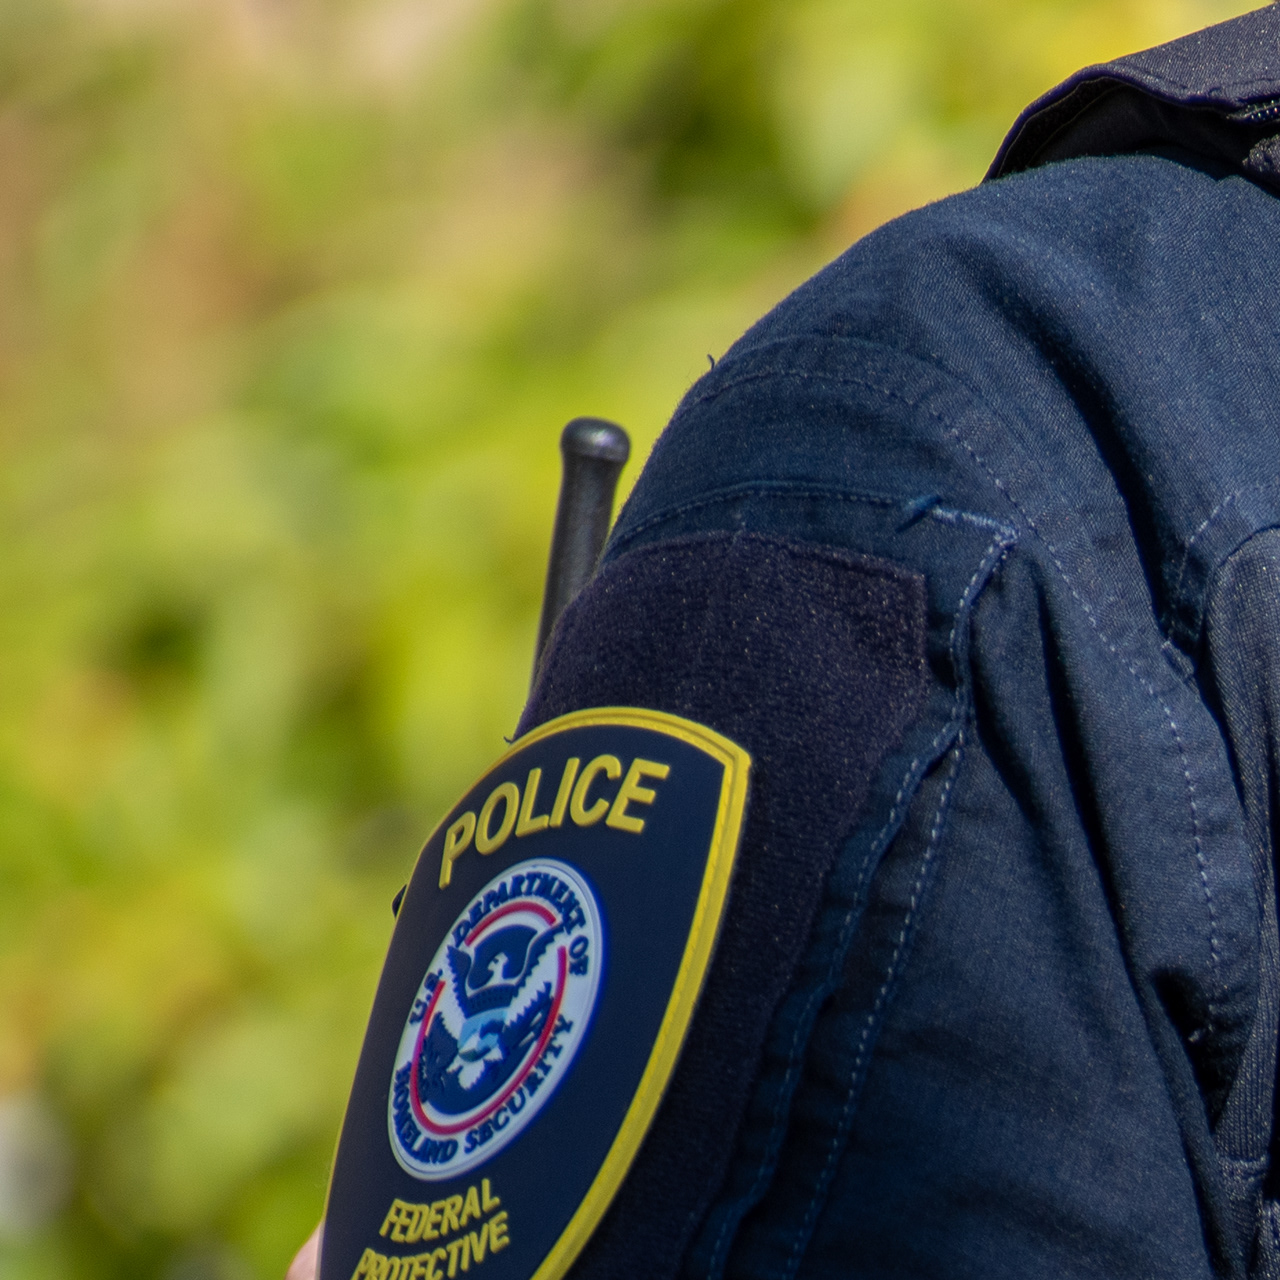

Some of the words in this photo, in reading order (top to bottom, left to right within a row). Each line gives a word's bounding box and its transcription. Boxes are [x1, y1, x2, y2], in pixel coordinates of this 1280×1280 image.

[439, 753, 670, 889] POLICE
[451, 871, 587, 948] DEPARTMENT
[568, 934, 590, 978] OF
[464, 1012, 573, 1153] SECURITY
[380, 1178, 501, 1244] FEDERAL
